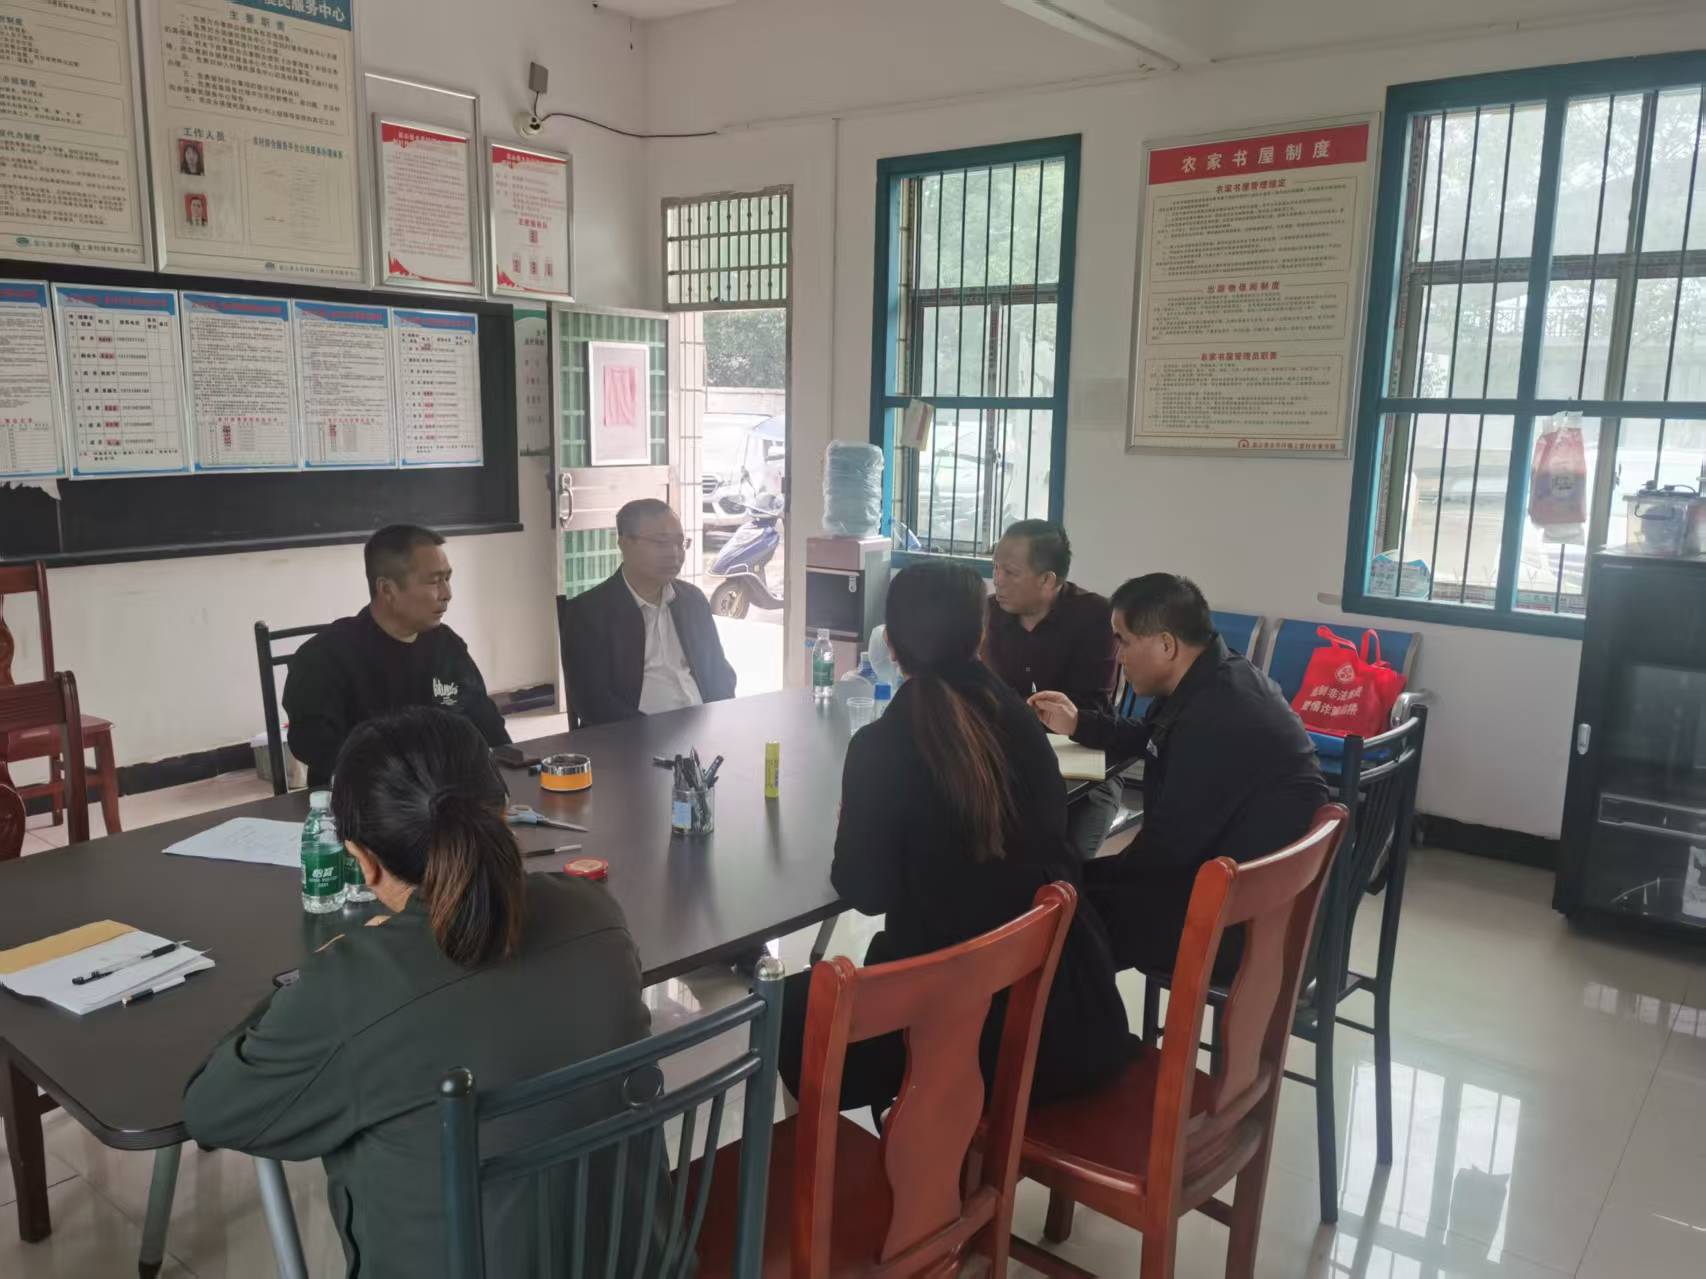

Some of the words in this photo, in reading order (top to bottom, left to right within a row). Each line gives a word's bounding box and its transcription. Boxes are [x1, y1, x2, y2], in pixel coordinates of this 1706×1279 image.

[183, 127, 225, 141] 工作人员
[1181, 138, 1333, 174] 农家书屋制度
